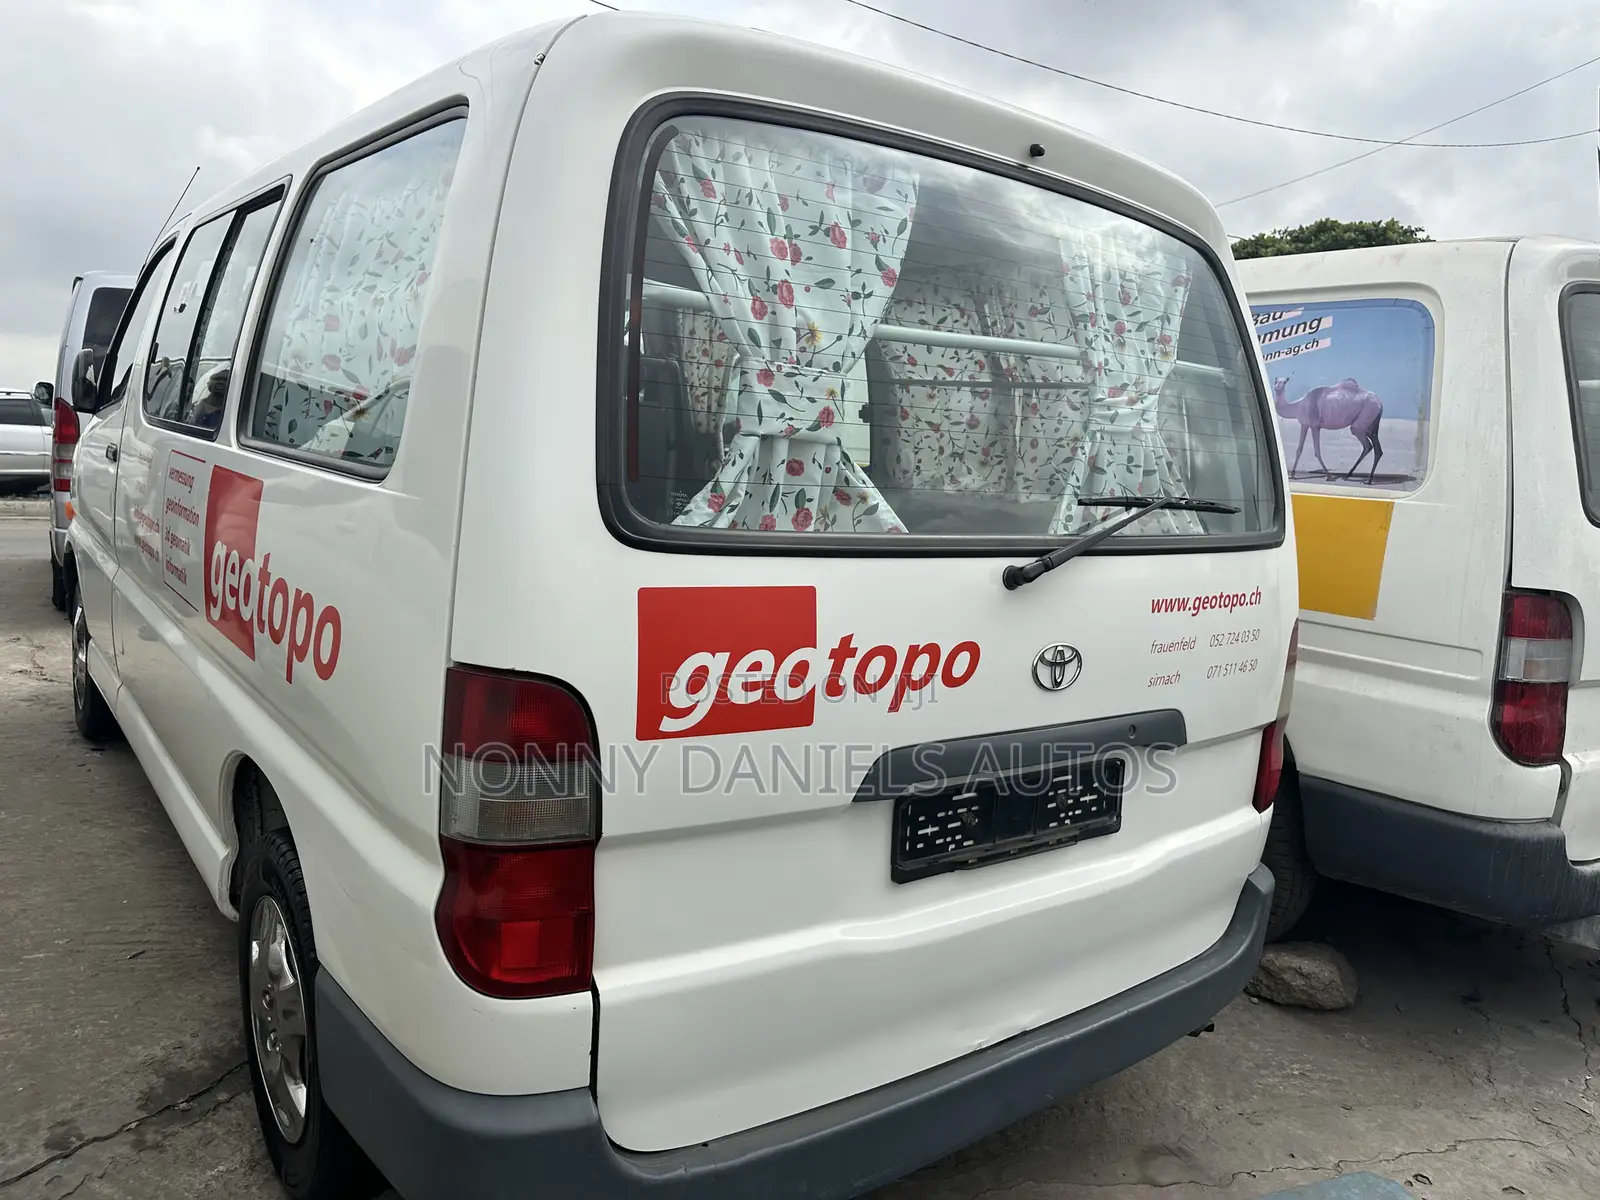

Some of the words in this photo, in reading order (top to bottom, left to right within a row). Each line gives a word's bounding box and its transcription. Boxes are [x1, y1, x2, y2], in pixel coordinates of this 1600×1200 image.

[210, 541, 342, 685] geotopo
[1151, 586, 1262, 617] www.geotopo.ch
[1150, 636, 1197, 654] frauenfeld
[1209, 632, 1225, 648] 052
[1226, 631, 1240, 646] 724
[1240, 629, 1250, 643] 03
[1251, 628, 1261, 642] 50
[659, 633, 981, 732] geotopo
[1147, 670, 1181, 688] sirnach
[1206, 665, 1222, 679] 071
[1223, 661, 1238, 677] 511
[1238, 659, 1248, 673] 46
[1249, 658, 1258, 672] 50
